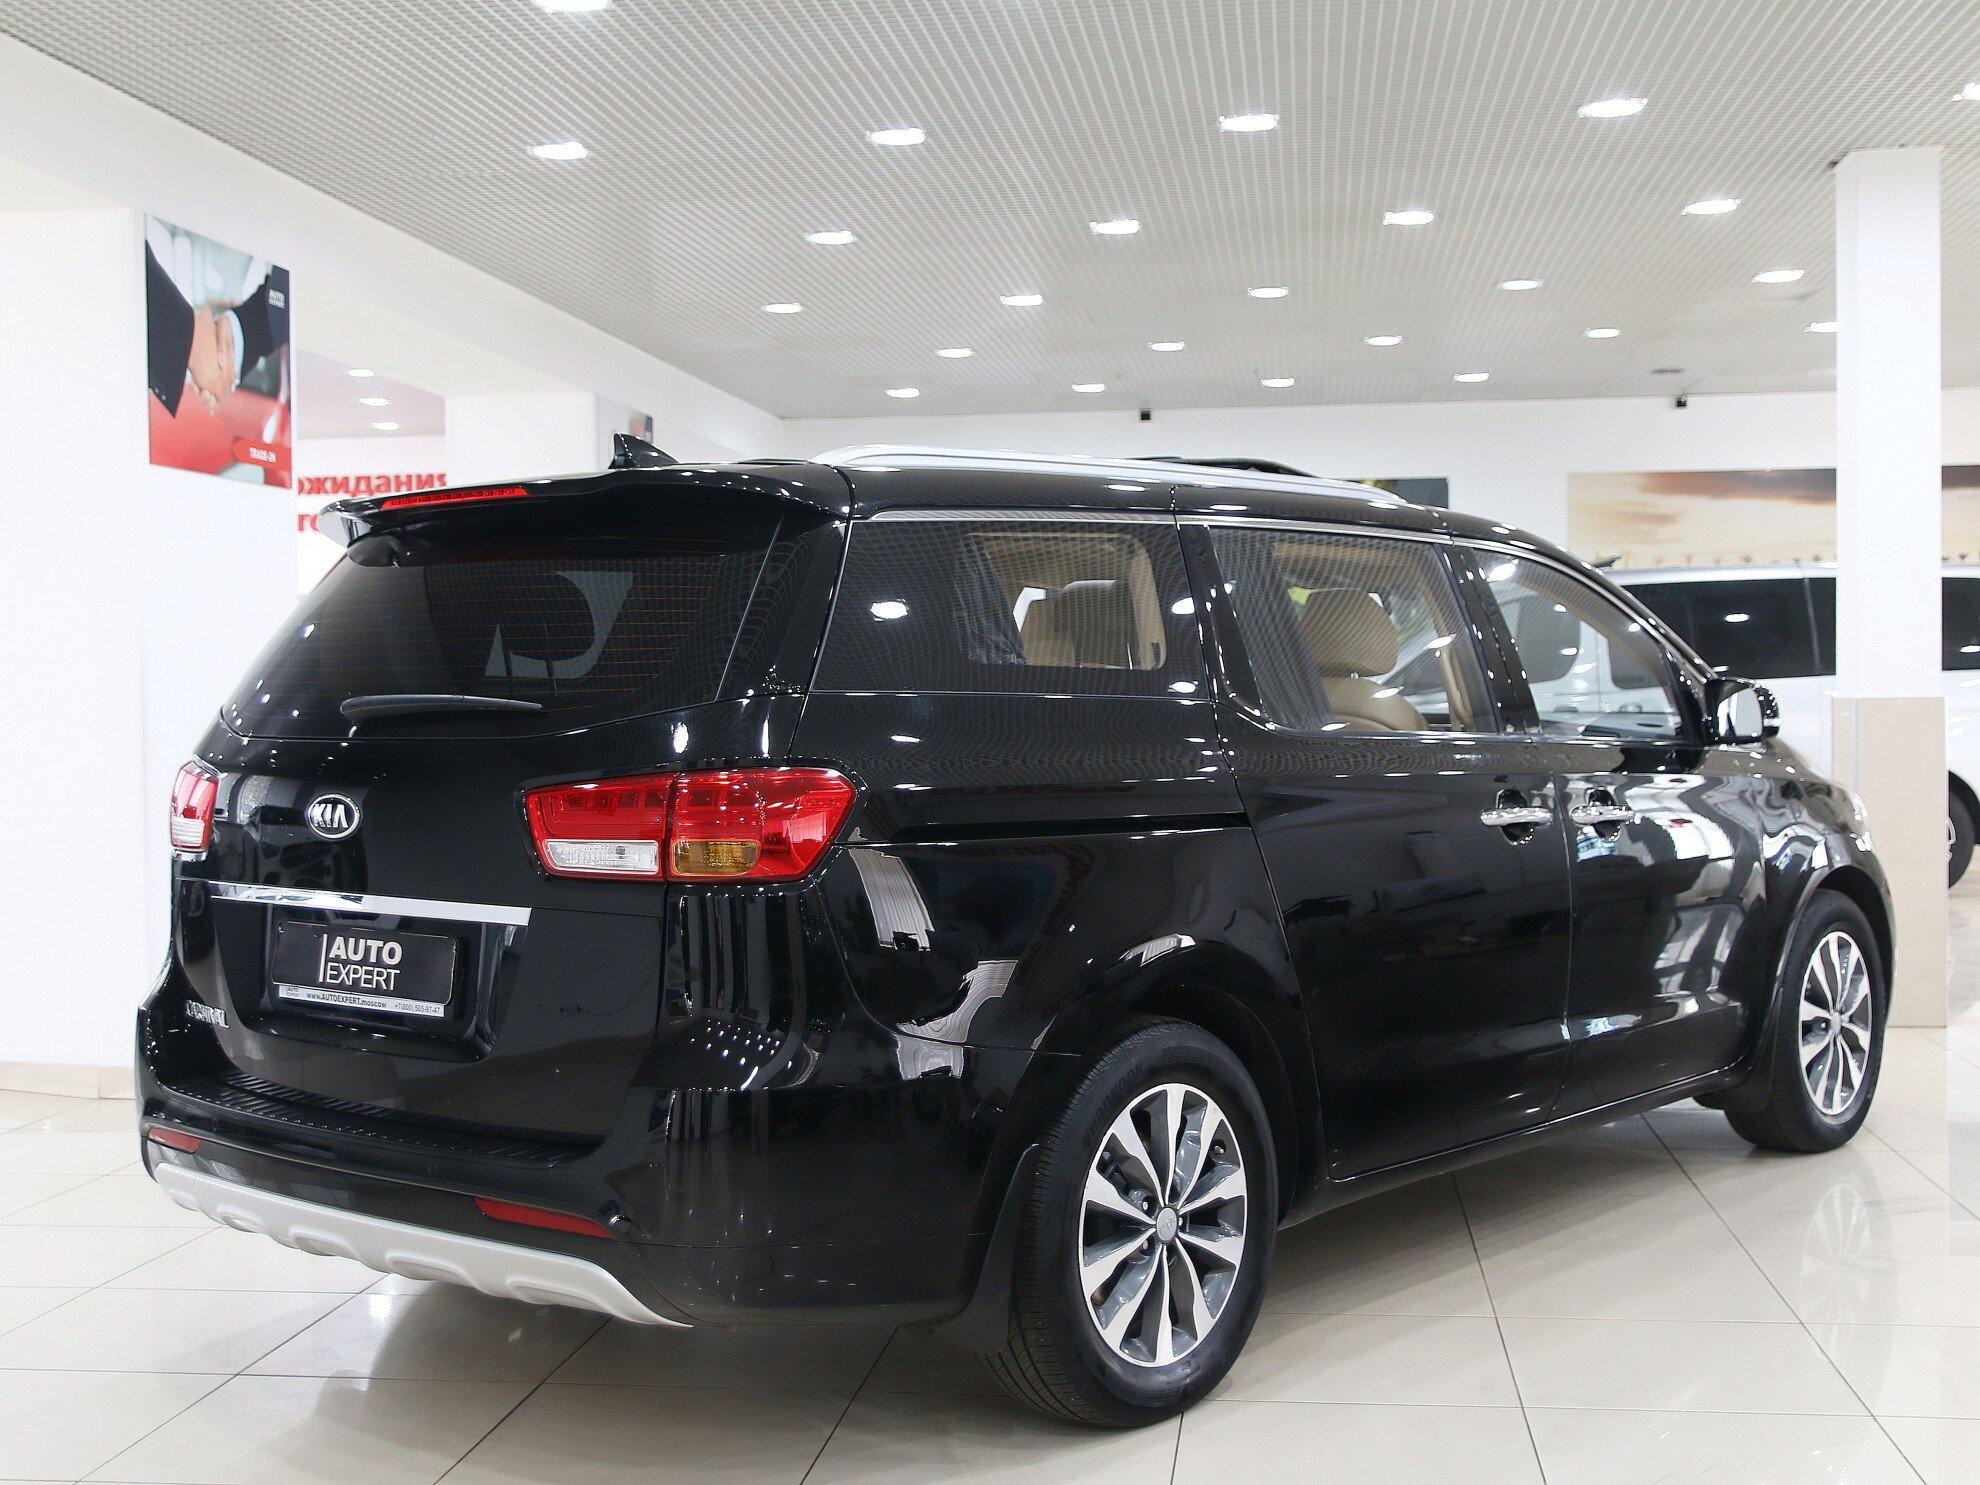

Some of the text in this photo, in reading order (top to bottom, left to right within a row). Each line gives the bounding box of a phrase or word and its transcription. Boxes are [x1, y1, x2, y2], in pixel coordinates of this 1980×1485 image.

[311, 803, 349, 828] KIA
[329, 936, 402, 965] AUTO
[326, 962, 400, 991] EXPERT
[306, 993, 387, 1008] www.AUTOEXPERT.moscow
